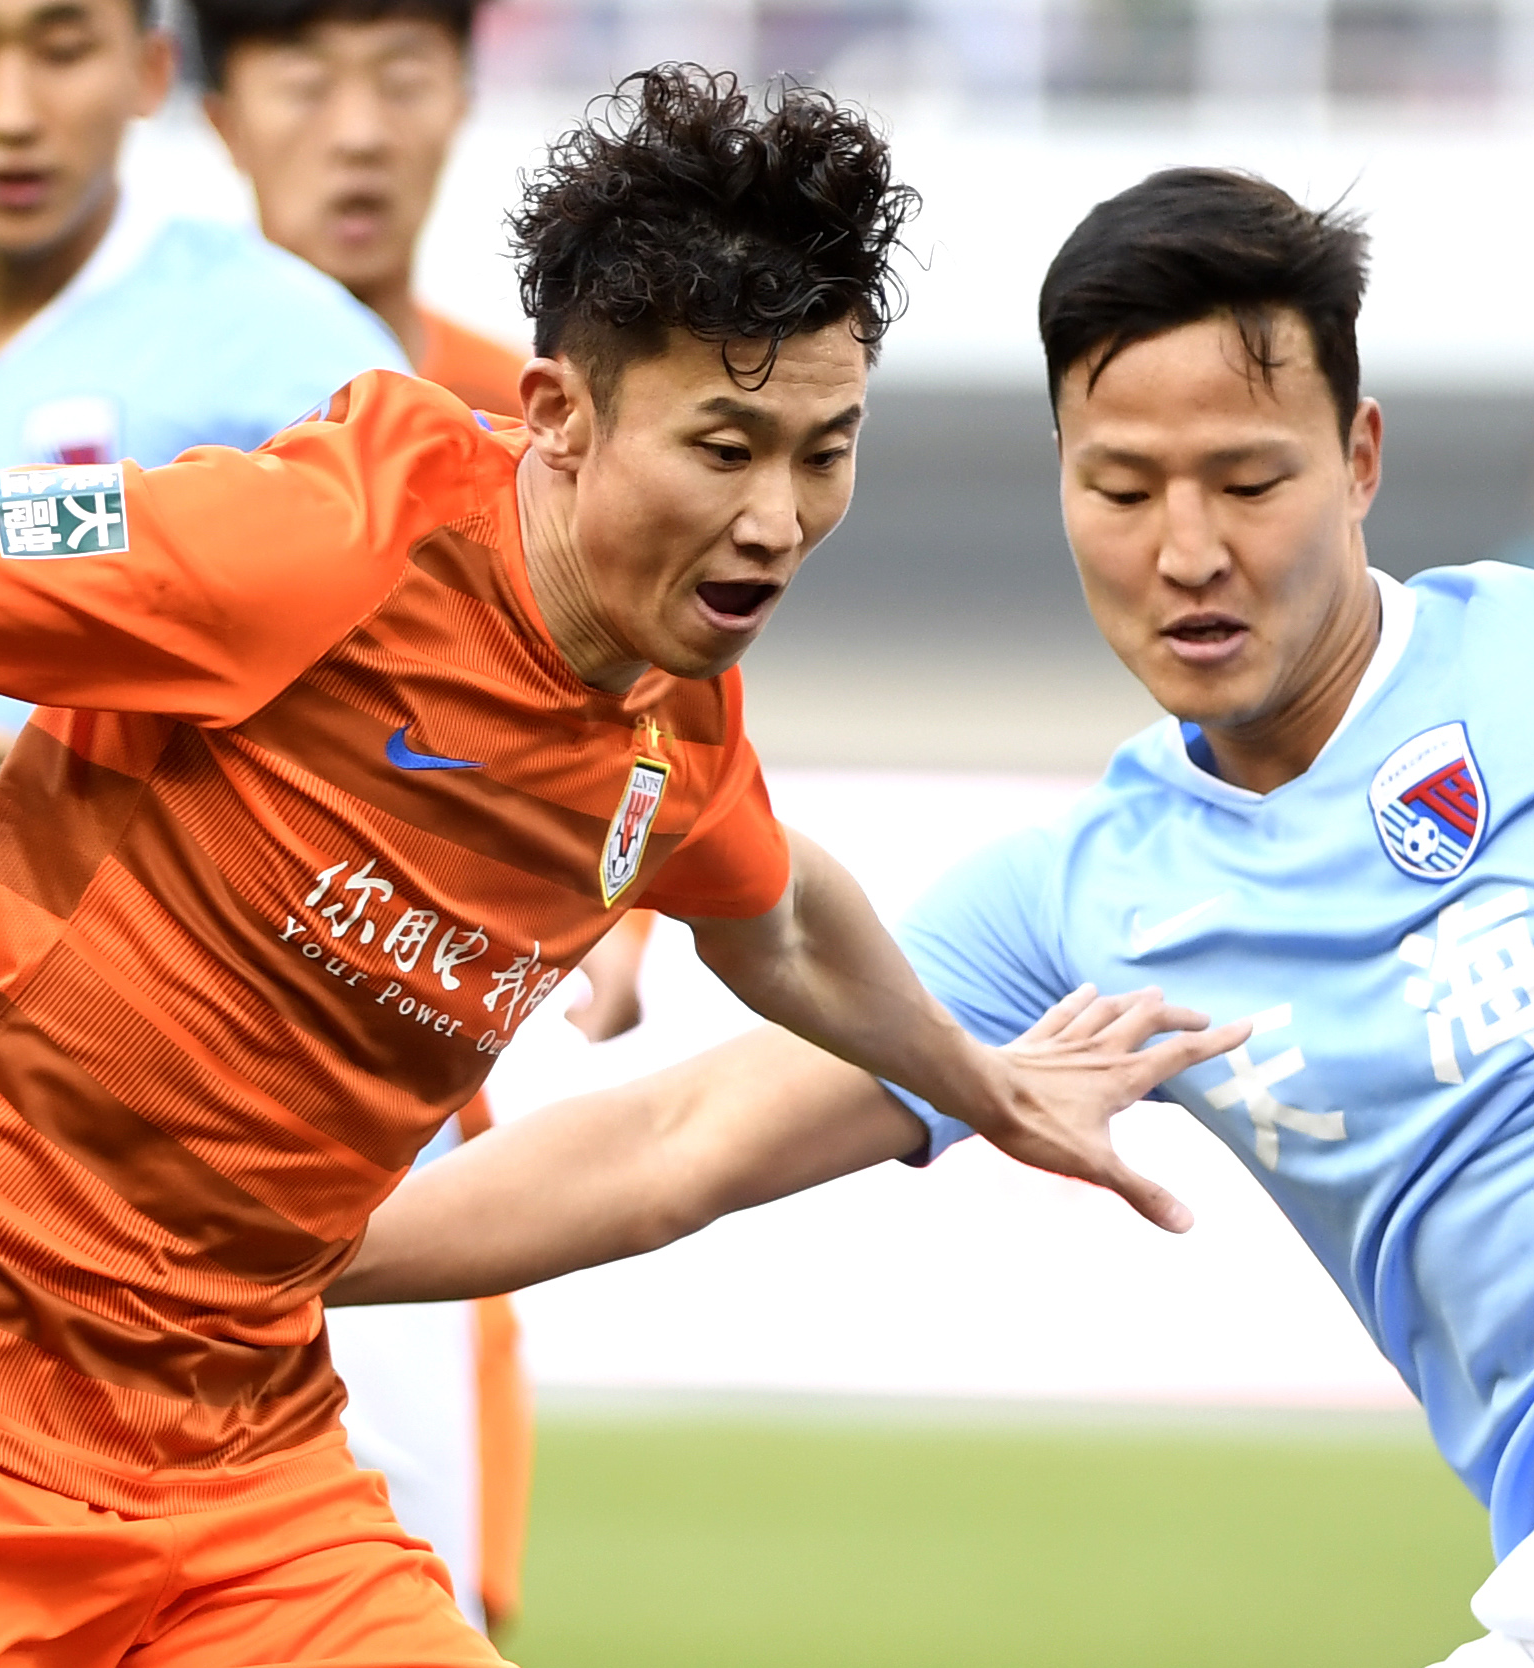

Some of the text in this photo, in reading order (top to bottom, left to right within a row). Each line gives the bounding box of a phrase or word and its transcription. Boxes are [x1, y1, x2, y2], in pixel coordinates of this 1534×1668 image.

[632, 772, 660, 793] LNTS
[278, 915, 369, 988] Your
[375, 980, 463, 1039] Power
